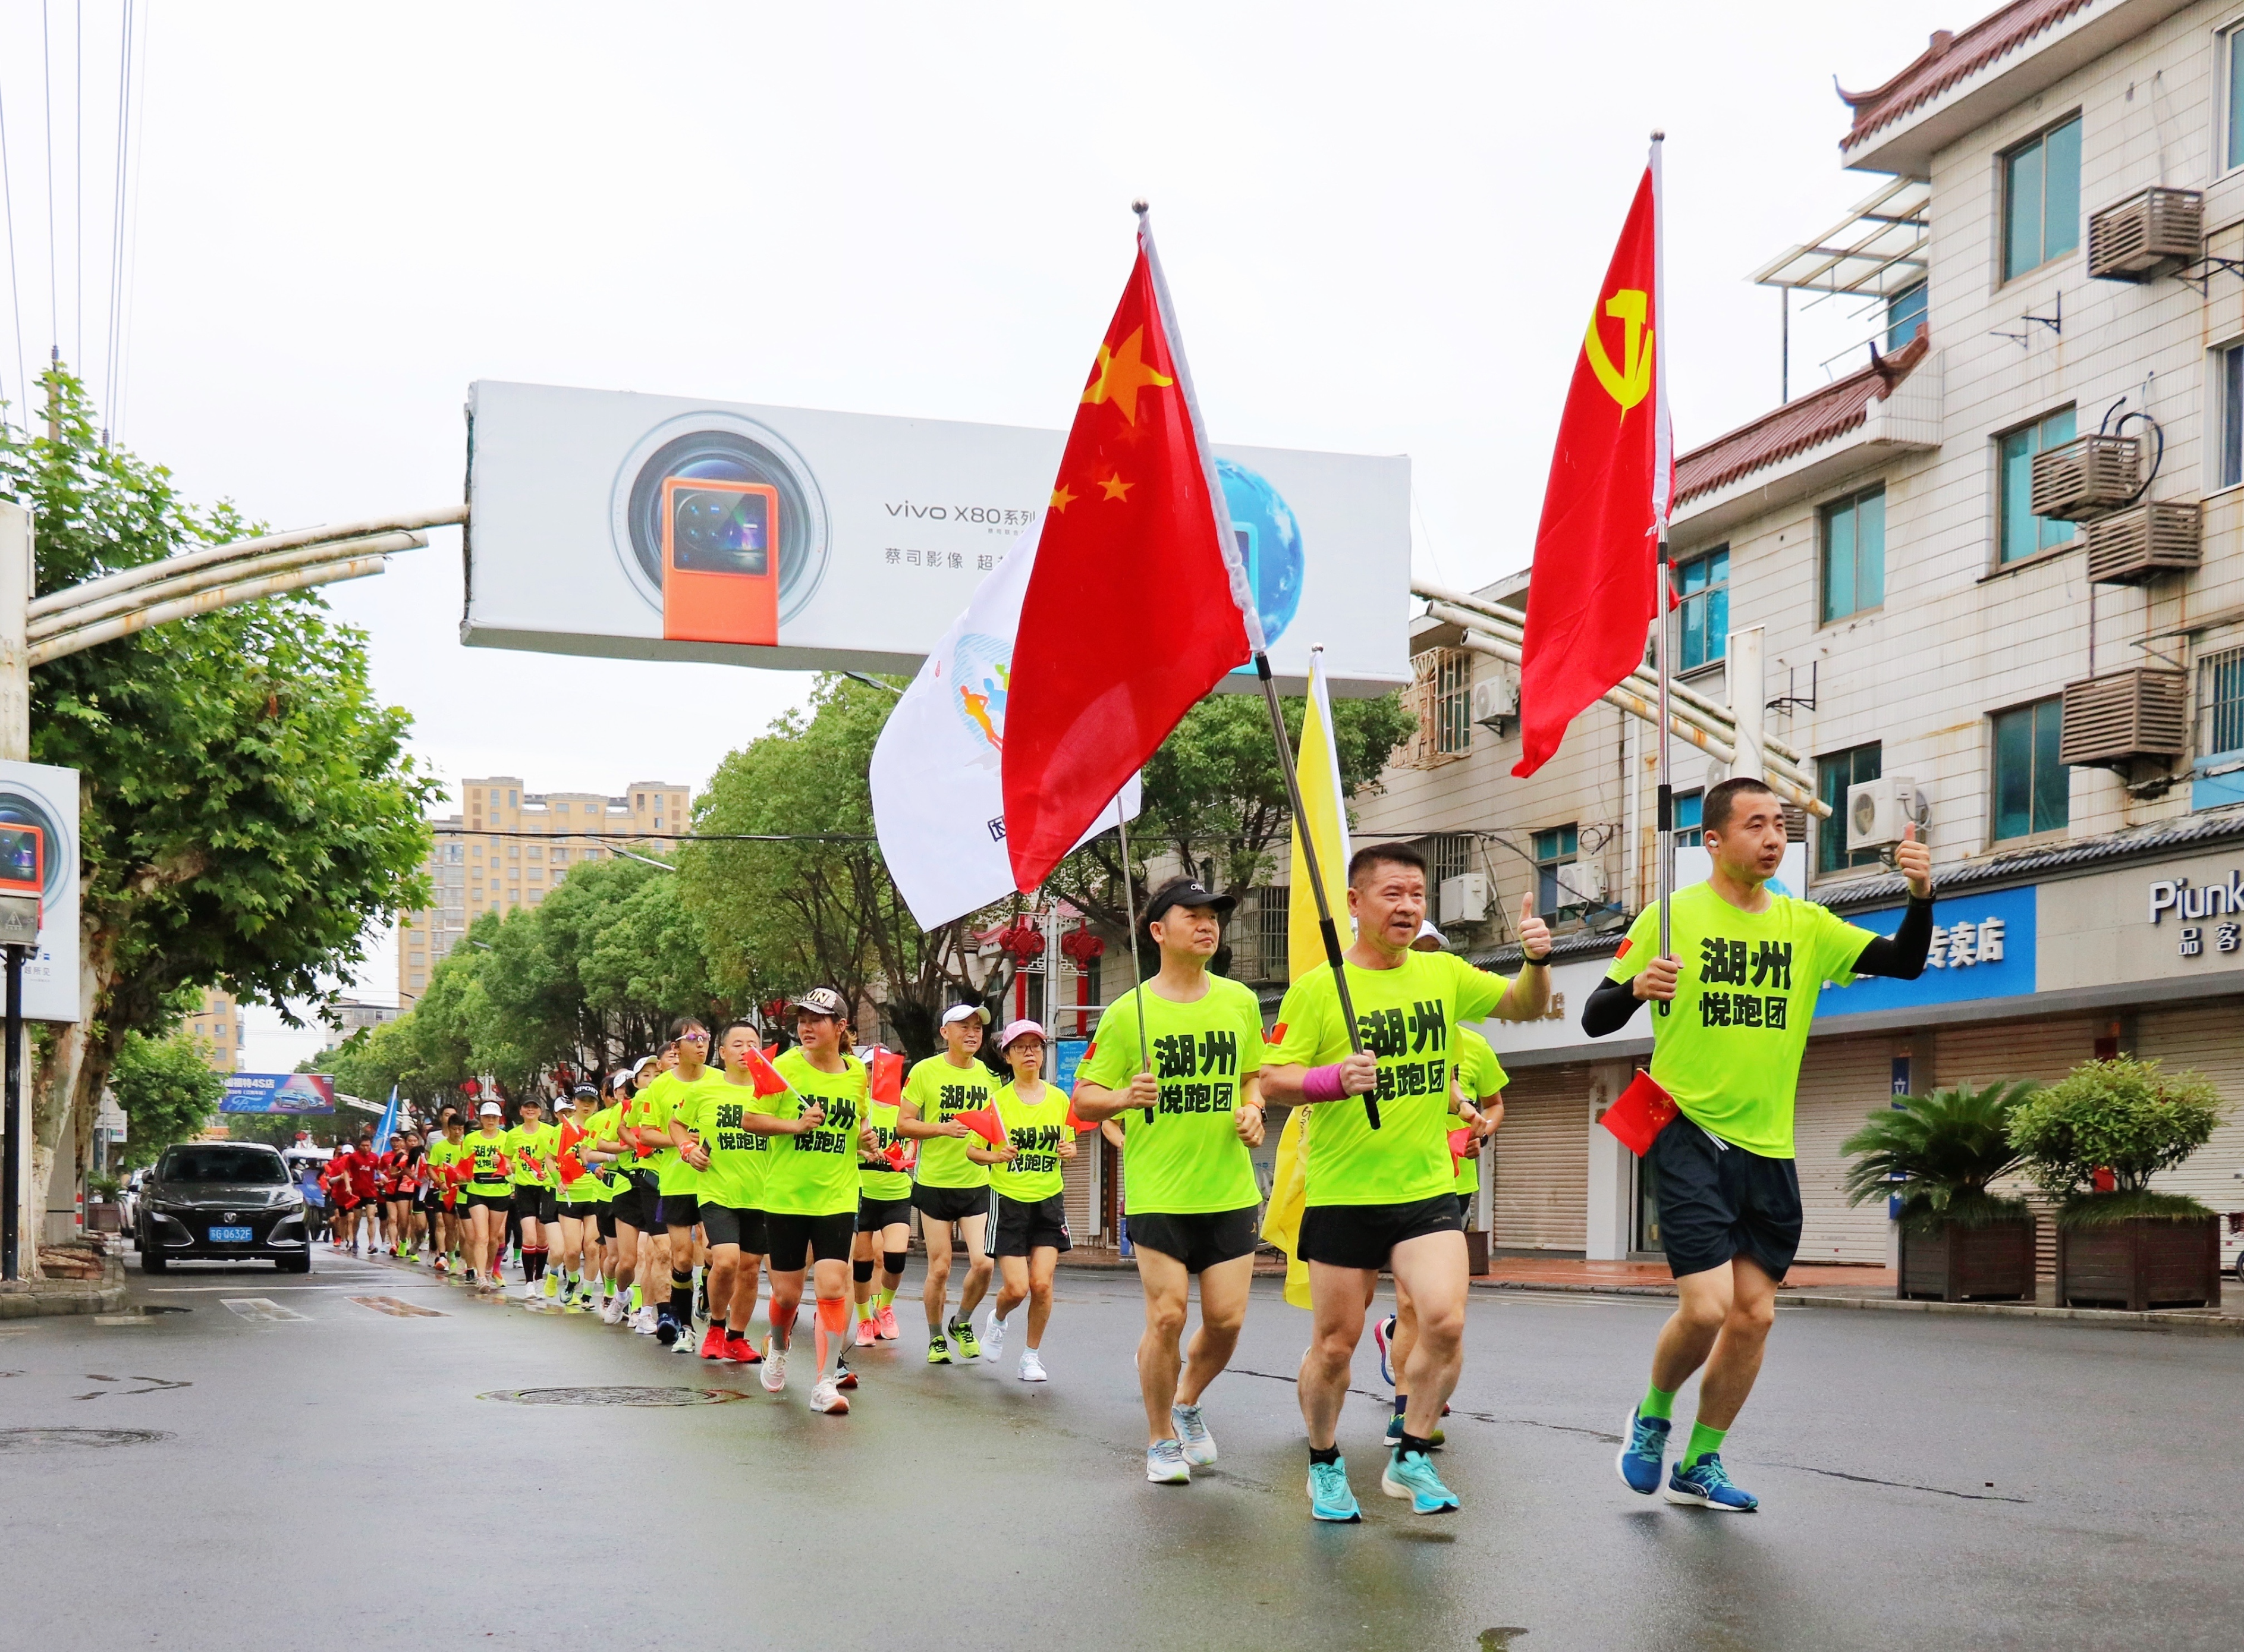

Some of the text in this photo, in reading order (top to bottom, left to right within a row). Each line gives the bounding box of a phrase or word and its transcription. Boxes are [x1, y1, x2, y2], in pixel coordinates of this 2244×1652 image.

[885, 500, 1035, 526] vivo X80系列
[885, 548, 1003, 571] 蔡司影像 超
[2149, 869, 2244, 924] Piunk
[2178, 922, 2238, 956] 品客
[1699, 937, 1792, 990] 湖州
[1699, 992, 1787, 1030] 悦跑团
[1357, 999, 1447, 1059] 湖州
[1153, 1031, 1237, 1079] 湖州
[797, 1094, 856, 1130] 湖州
[939, 1085, 988, 1111] 湖州
[1158, 1083, 1233, 1114] 悦跑团
[717, 1132, 767, 1151] 悦跑团
[793, 1130, 846, 1154] 悦跑团
[1011, 1125, 1061, 1154] 湖州
[1007, 1155, 1058, 1173] 悦跑团
